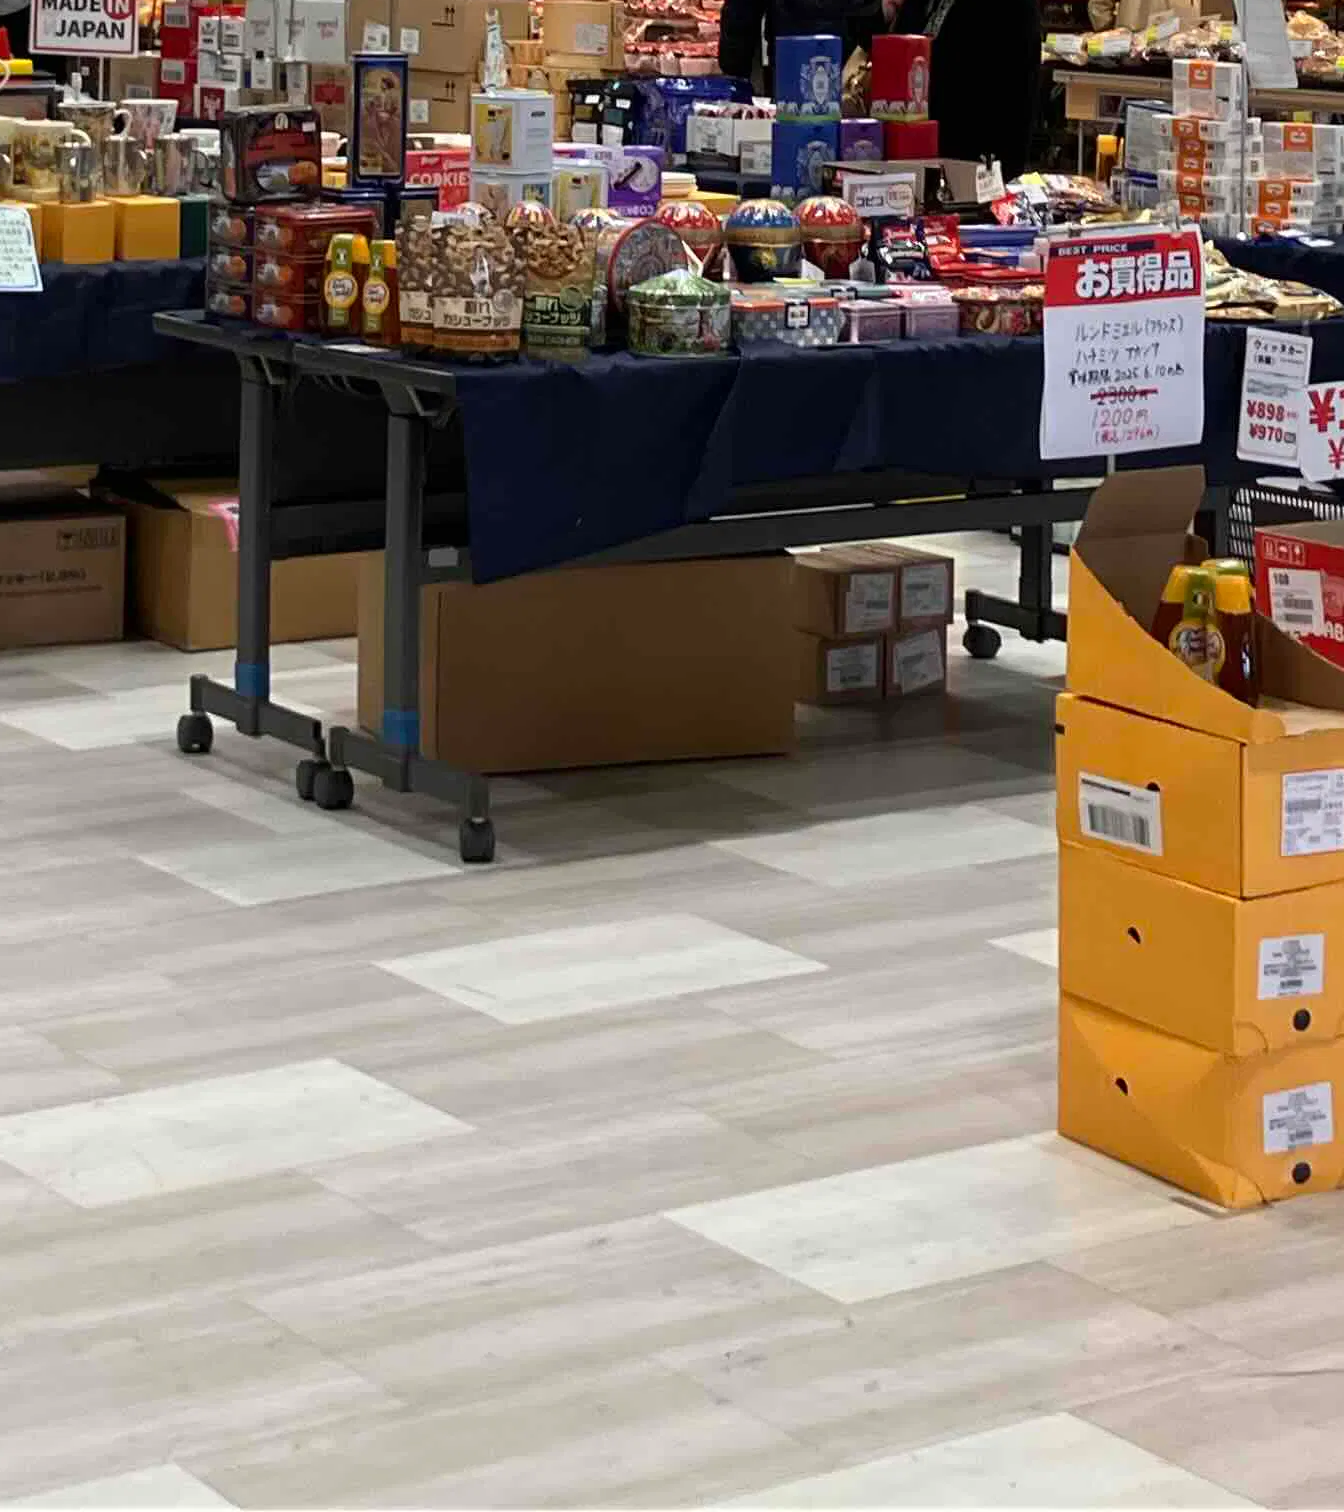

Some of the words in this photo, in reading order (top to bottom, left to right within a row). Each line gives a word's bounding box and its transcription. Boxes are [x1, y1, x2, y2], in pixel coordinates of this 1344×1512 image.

[56, 19, 126, 41] JAPAN
[409, 172, 470, 187] COOKIE
[1058, 244, 1087, 256] BEST
[1092, 243, 1128, 254] PRICE
[1075, 250, 1194, 298] お買得品
[1246, 399, 1286, 423] ¥898
[1249, 422, 1284, 442] ¥970
